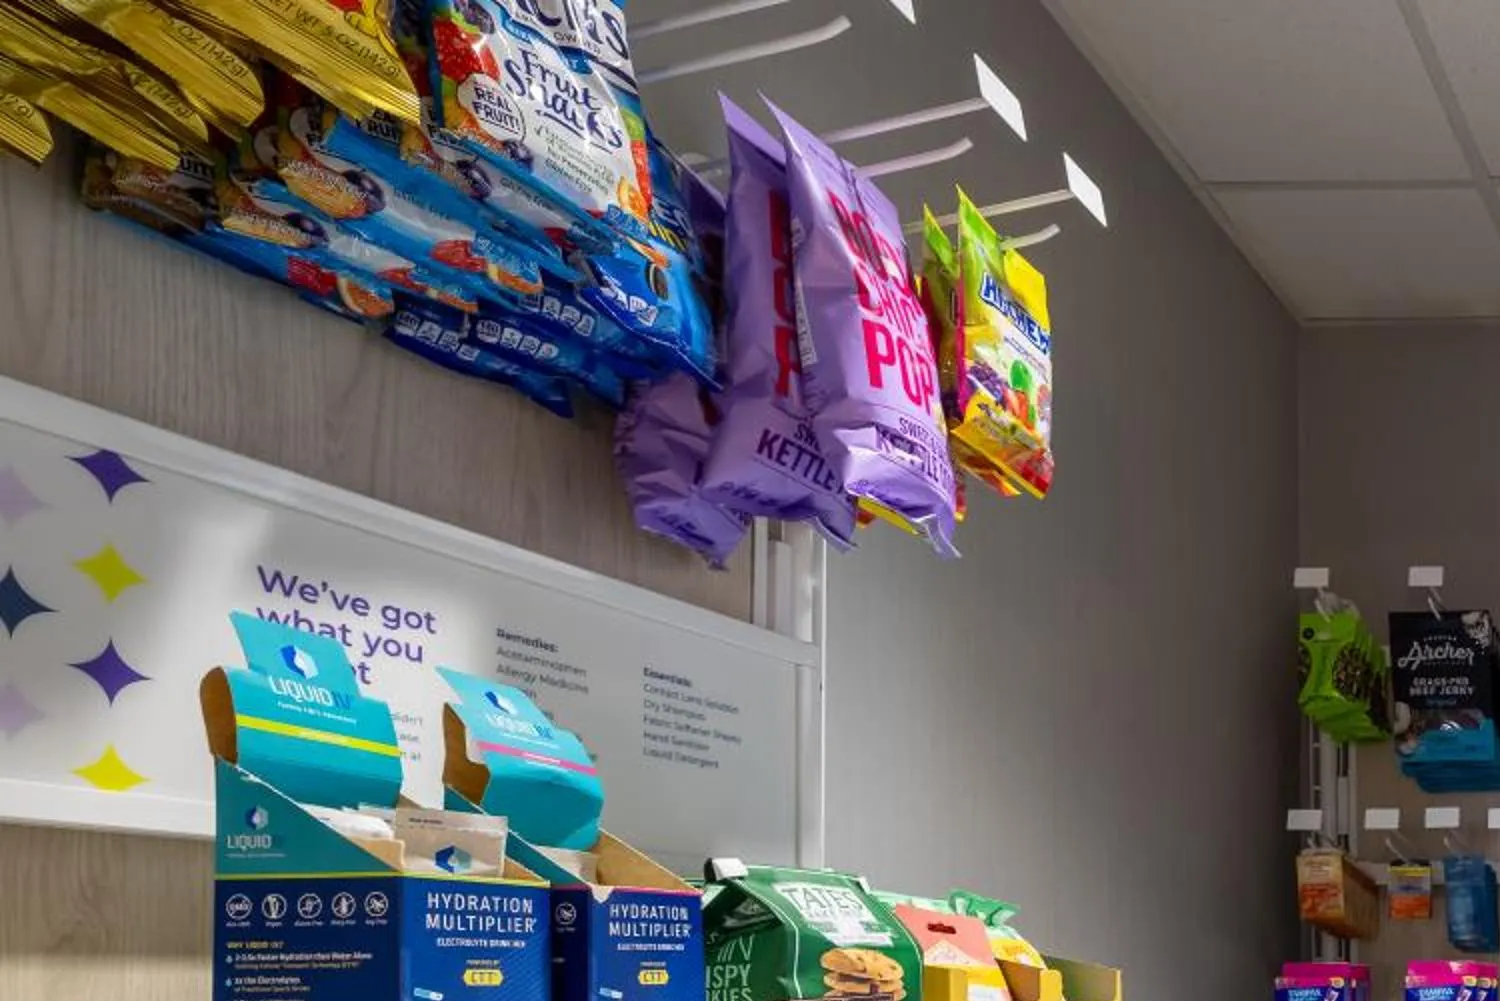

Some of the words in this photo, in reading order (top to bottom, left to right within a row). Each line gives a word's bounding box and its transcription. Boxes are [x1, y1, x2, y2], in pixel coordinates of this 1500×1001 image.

[474, 85, 514, 113] REAL
[471, 100, 521, 132] FRUIT!
[755, 427, 836, 489] KETTLE
[256, 564, 370, 617] We've
[381, 603, 437, 635] got
[362, 631, 424, 665] you
[1397, 640, 1475, 671] Archer
[268, 675, 334, 707] LIQUID
[1439, 685, 1475, 697] JERKY
[226, 833, 273, 853] LIQUID
[426, 891, 534, 914] HYDRATION
[609, 903, 690, 922] HYDRATION
[425, 913, 536, 934] MULTIPLIER
[608, 921, 692, 939] MULTIPLIER
[704, 963, 752, 989] ISPY
